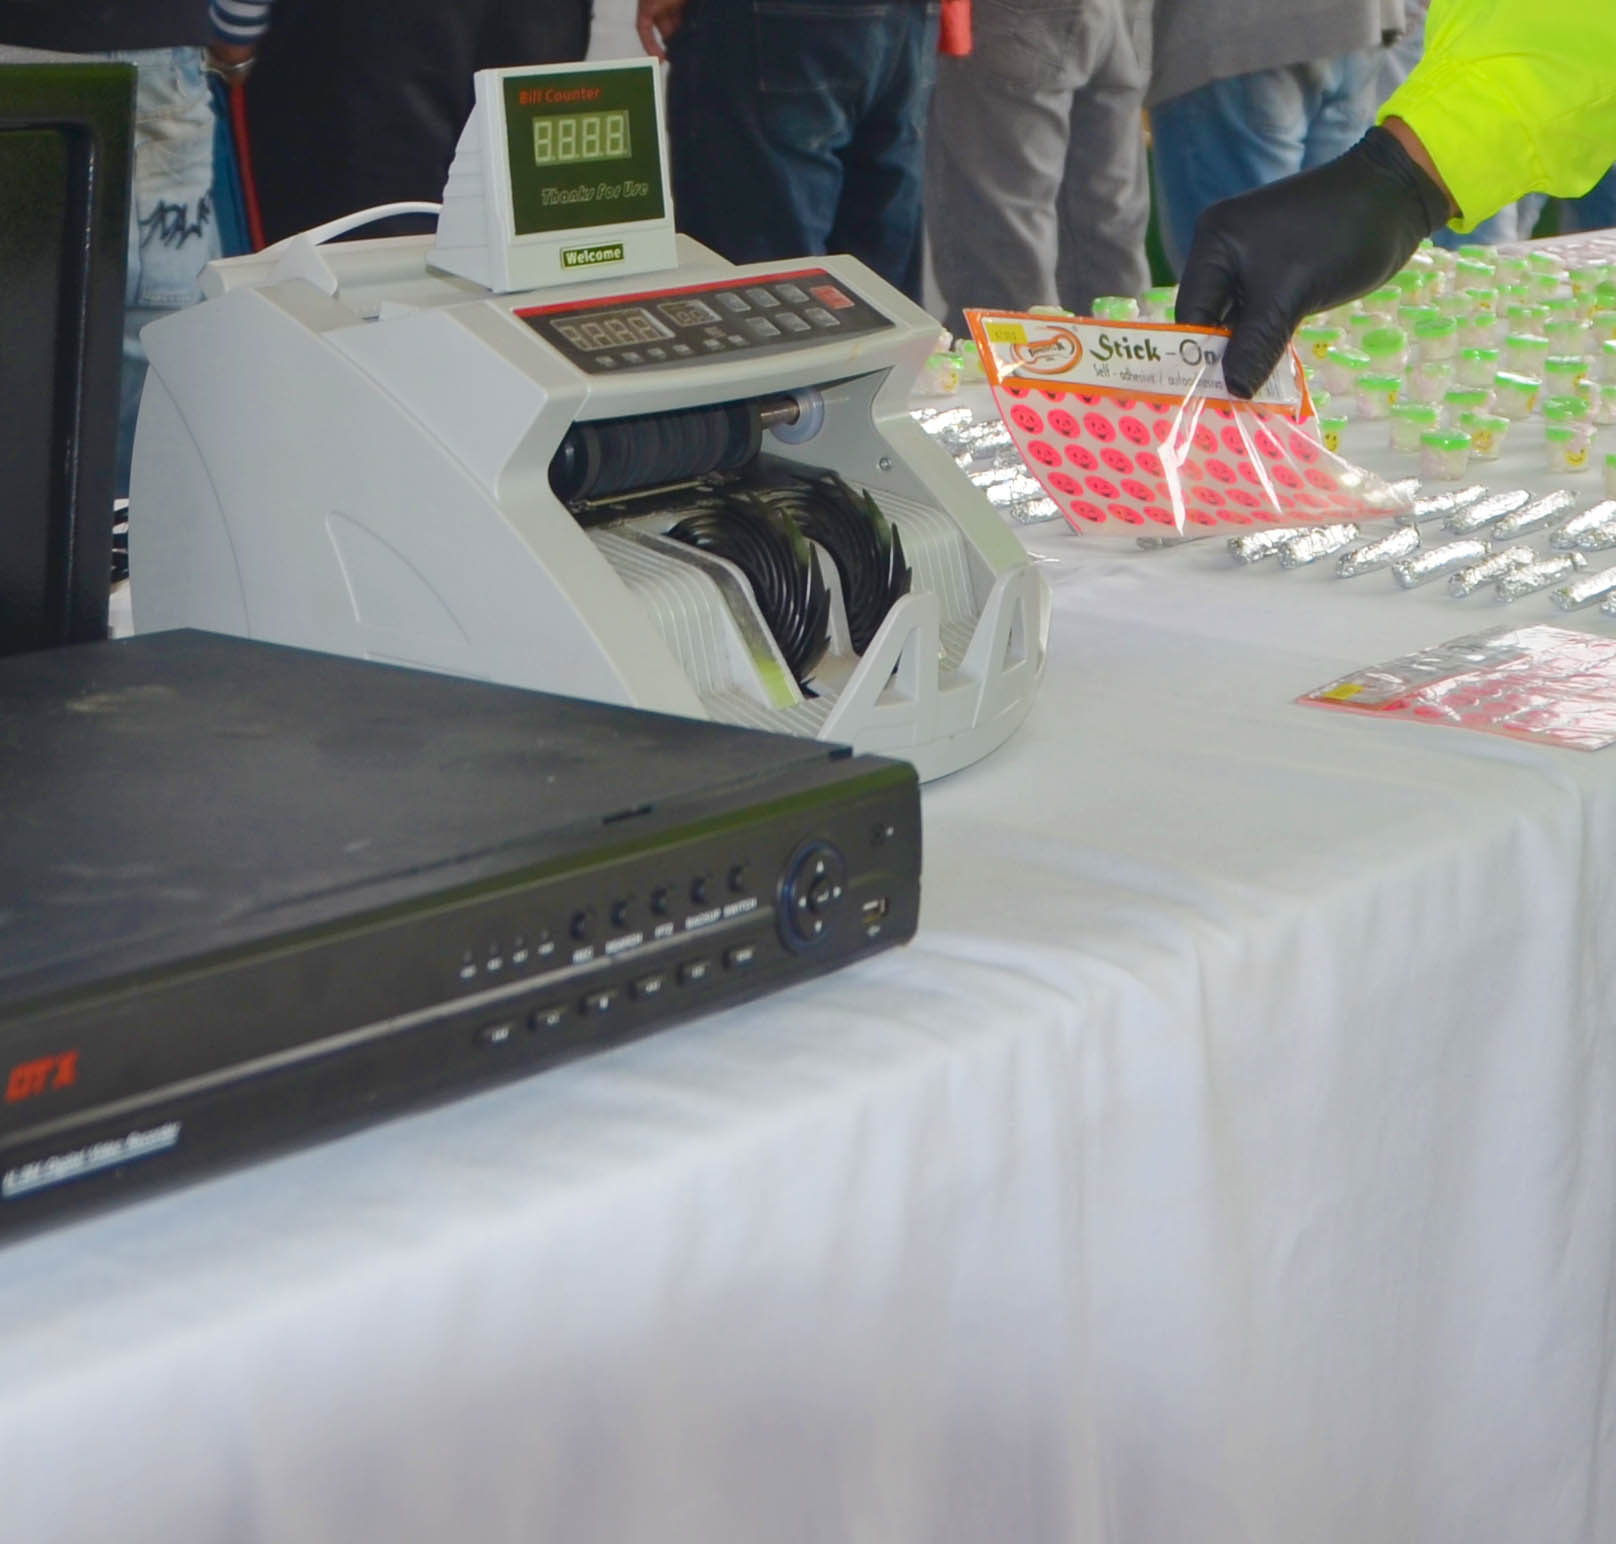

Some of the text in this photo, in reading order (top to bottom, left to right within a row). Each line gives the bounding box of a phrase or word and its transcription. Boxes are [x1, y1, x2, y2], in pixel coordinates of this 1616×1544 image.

[519, 87, 601, 105] Bill Counter
[542, 186, 594, 205] Thanks
[624, 181, 649, 197] Use
[565, 246, 622, 265] Welcome
